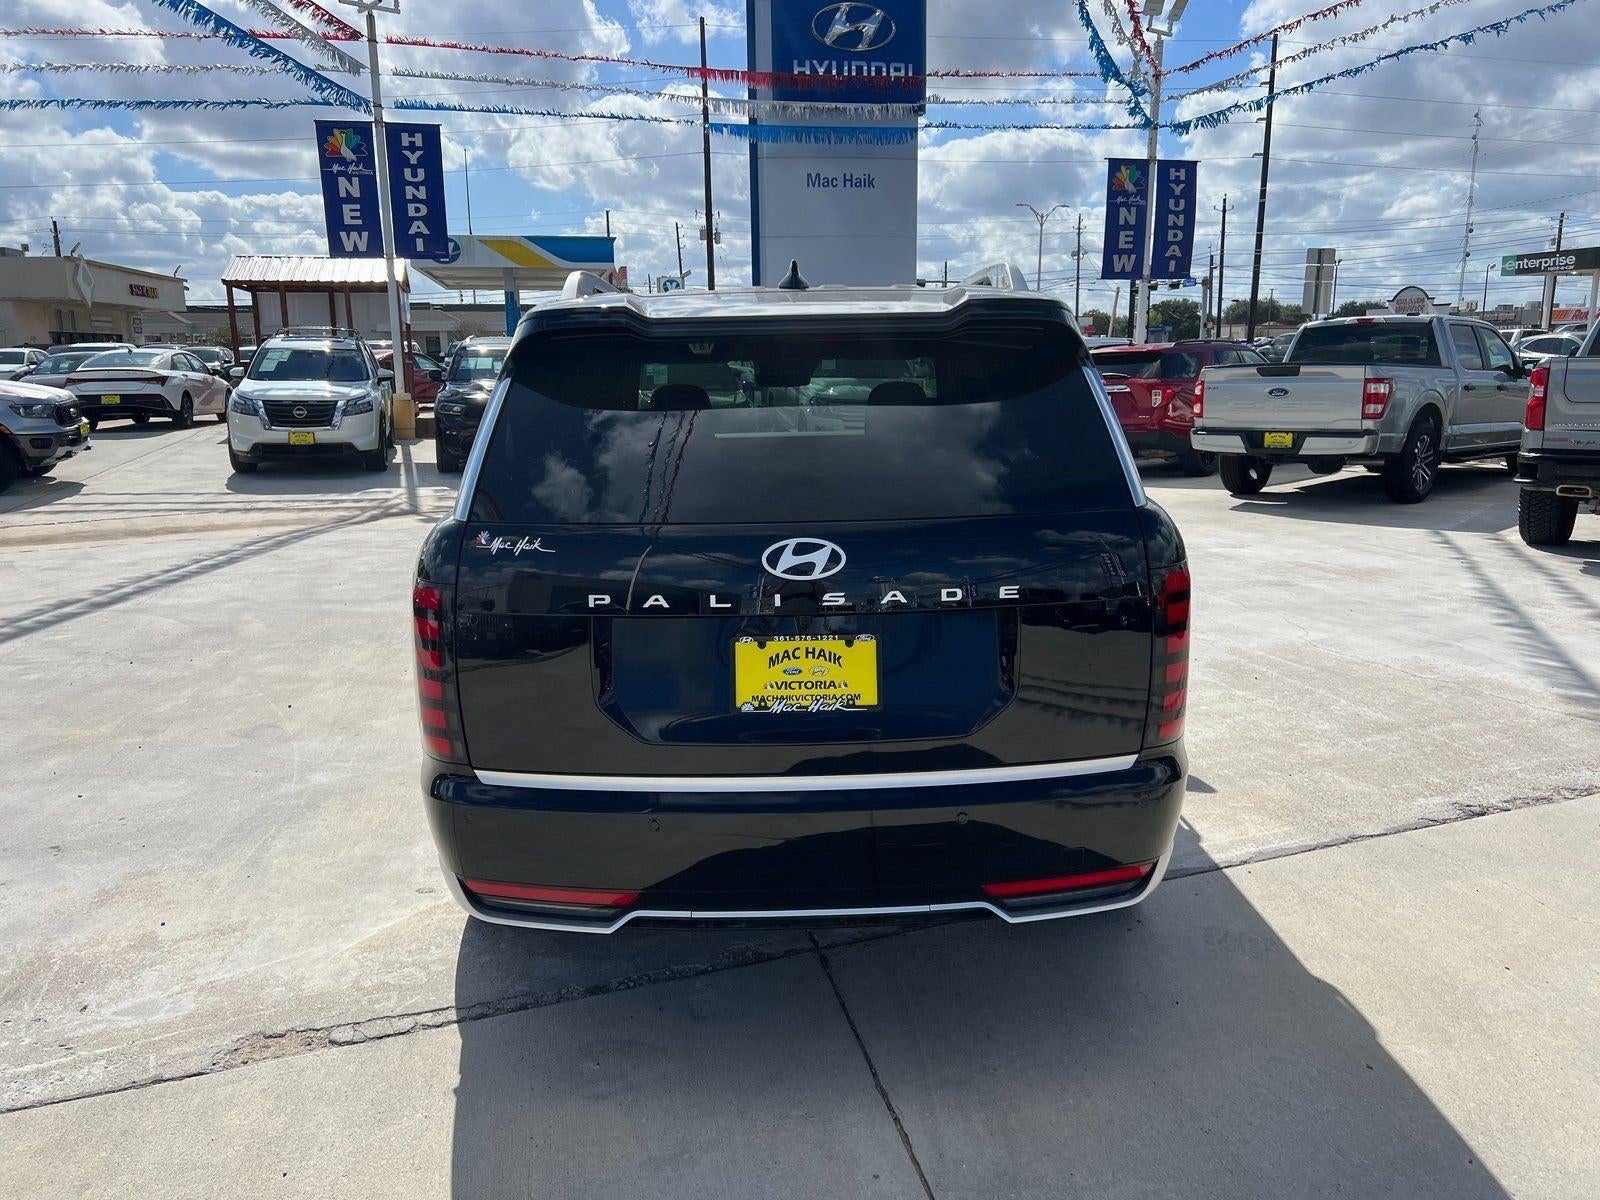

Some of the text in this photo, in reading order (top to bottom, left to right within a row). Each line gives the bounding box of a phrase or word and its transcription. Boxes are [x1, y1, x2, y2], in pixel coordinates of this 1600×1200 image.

[793, 59, 913, 77] HYUNDAI
[806, 172, 876, 189] Mac Haik
[400, 132, 430, 252] HYUNDAI
[337, 176, 369, 252] NEW
[1165, 168, 1186, 272] HYUNDAI
[1112, 206, 1137, 273] NEW
[1503, 253, 1576, 270] enterprise
[1269, 388, 1288, 397] Ford
[489, 536, 556, 556] Mac Haik
[588, 585, 1020, 608] PALISADE
[773, 634, 839, 642] 361-576-1221
[768, 646, 842, 669] MAC HAIK
[774, 680, 838, 691] VICTORIA
[768, 697, 866, 714] Mac Haik
